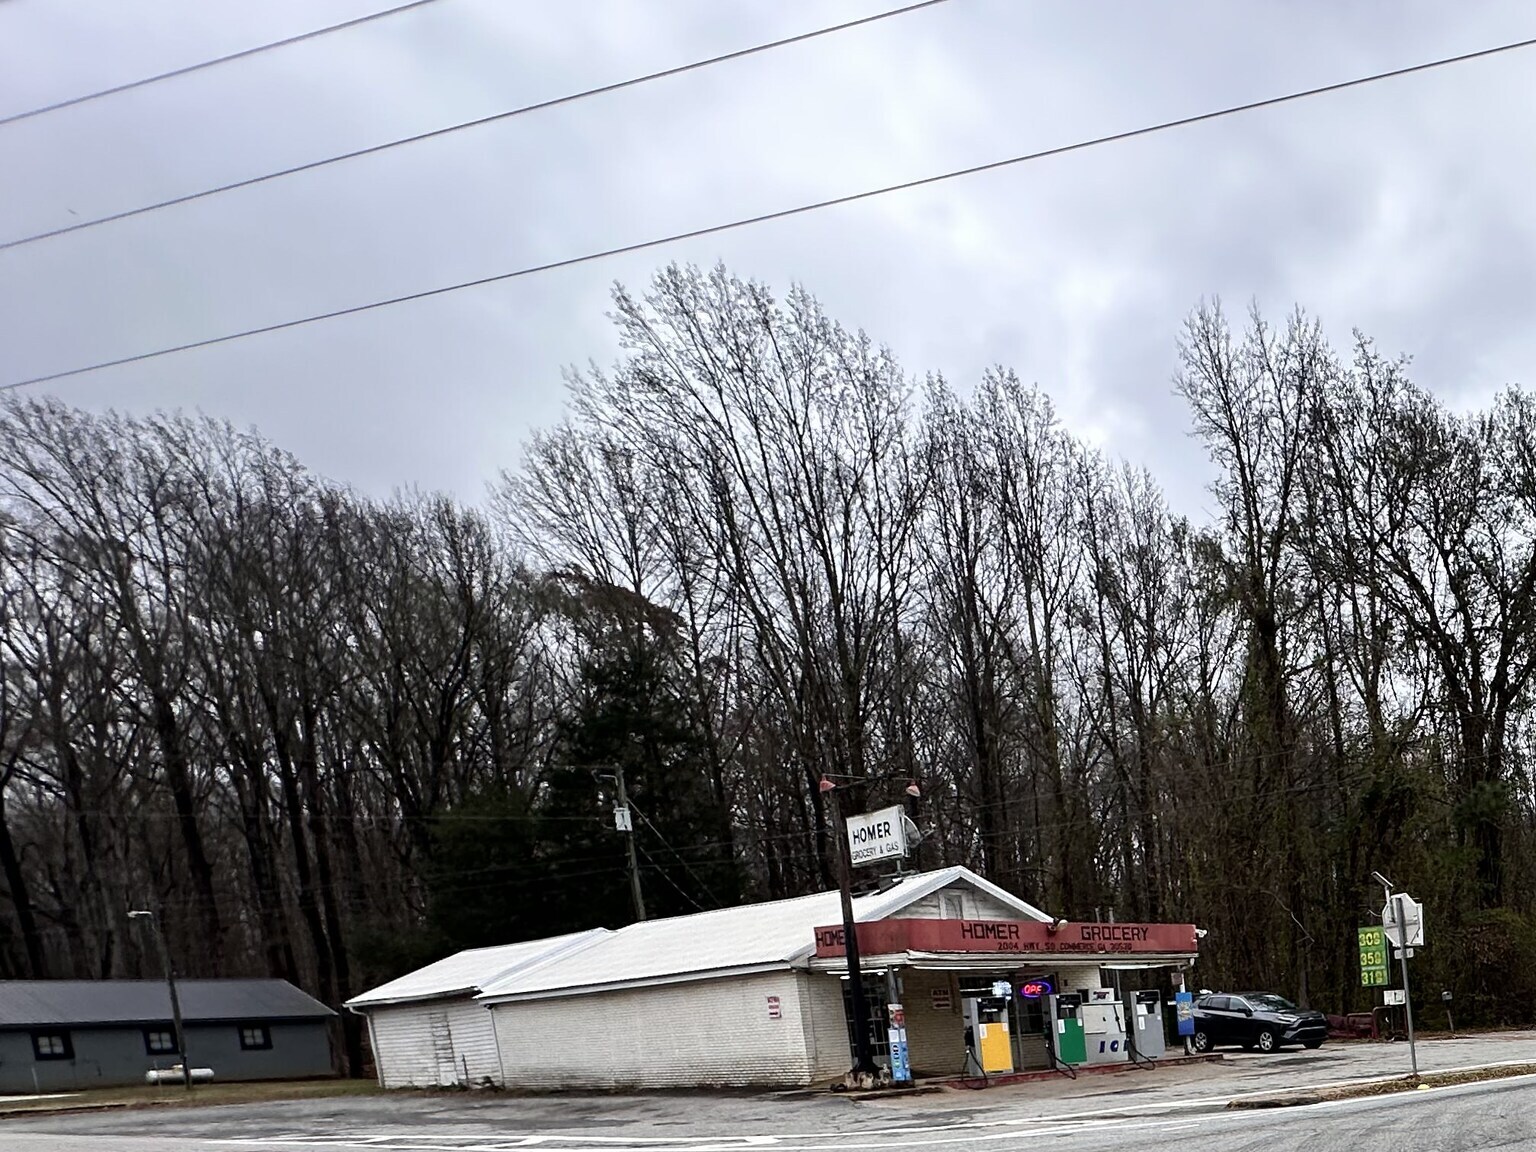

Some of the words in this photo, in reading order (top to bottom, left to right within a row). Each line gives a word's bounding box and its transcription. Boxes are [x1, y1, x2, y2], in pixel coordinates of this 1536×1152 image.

[853, 821, 891, 845] HOMER
[885, 841, 899, 852] GAS
[816, 929, 845, 947] HOME
[961, 923, 1020, 939] HOMER
[1081, 926, 1148, 941] GROCERY
